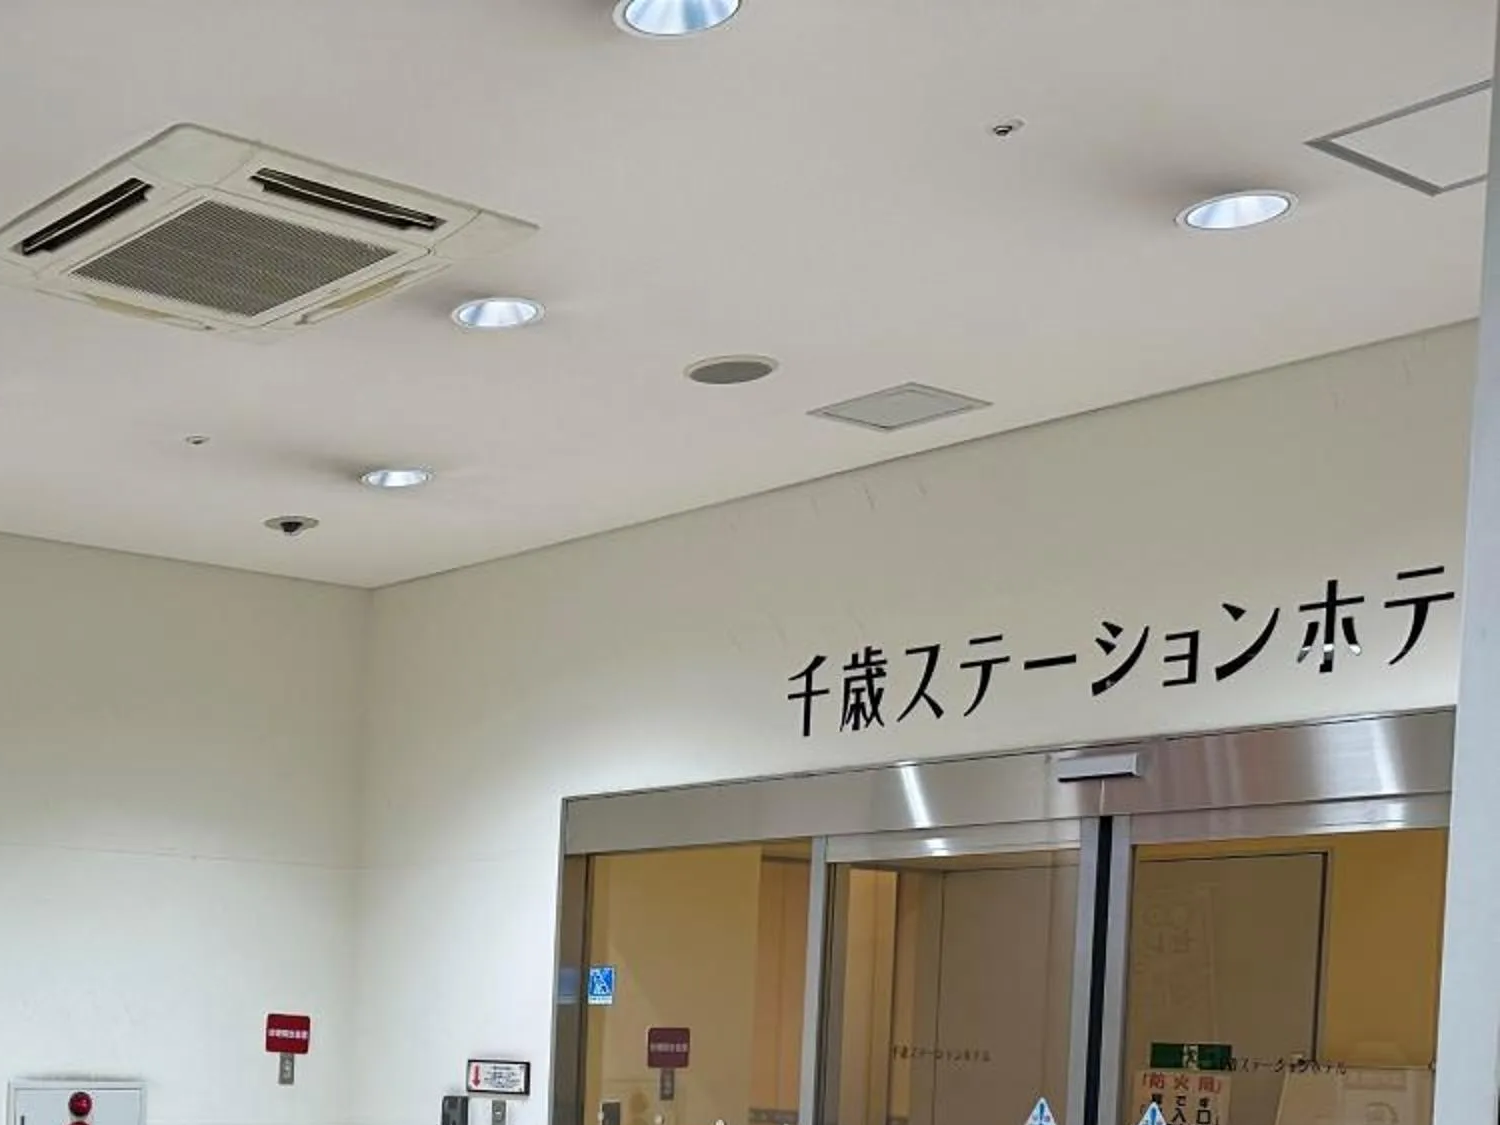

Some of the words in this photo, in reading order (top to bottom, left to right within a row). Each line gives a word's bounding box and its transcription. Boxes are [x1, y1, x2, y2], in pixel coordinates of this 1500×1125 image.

[786, 565, 1456, 738] 千歳ステーションホテ
